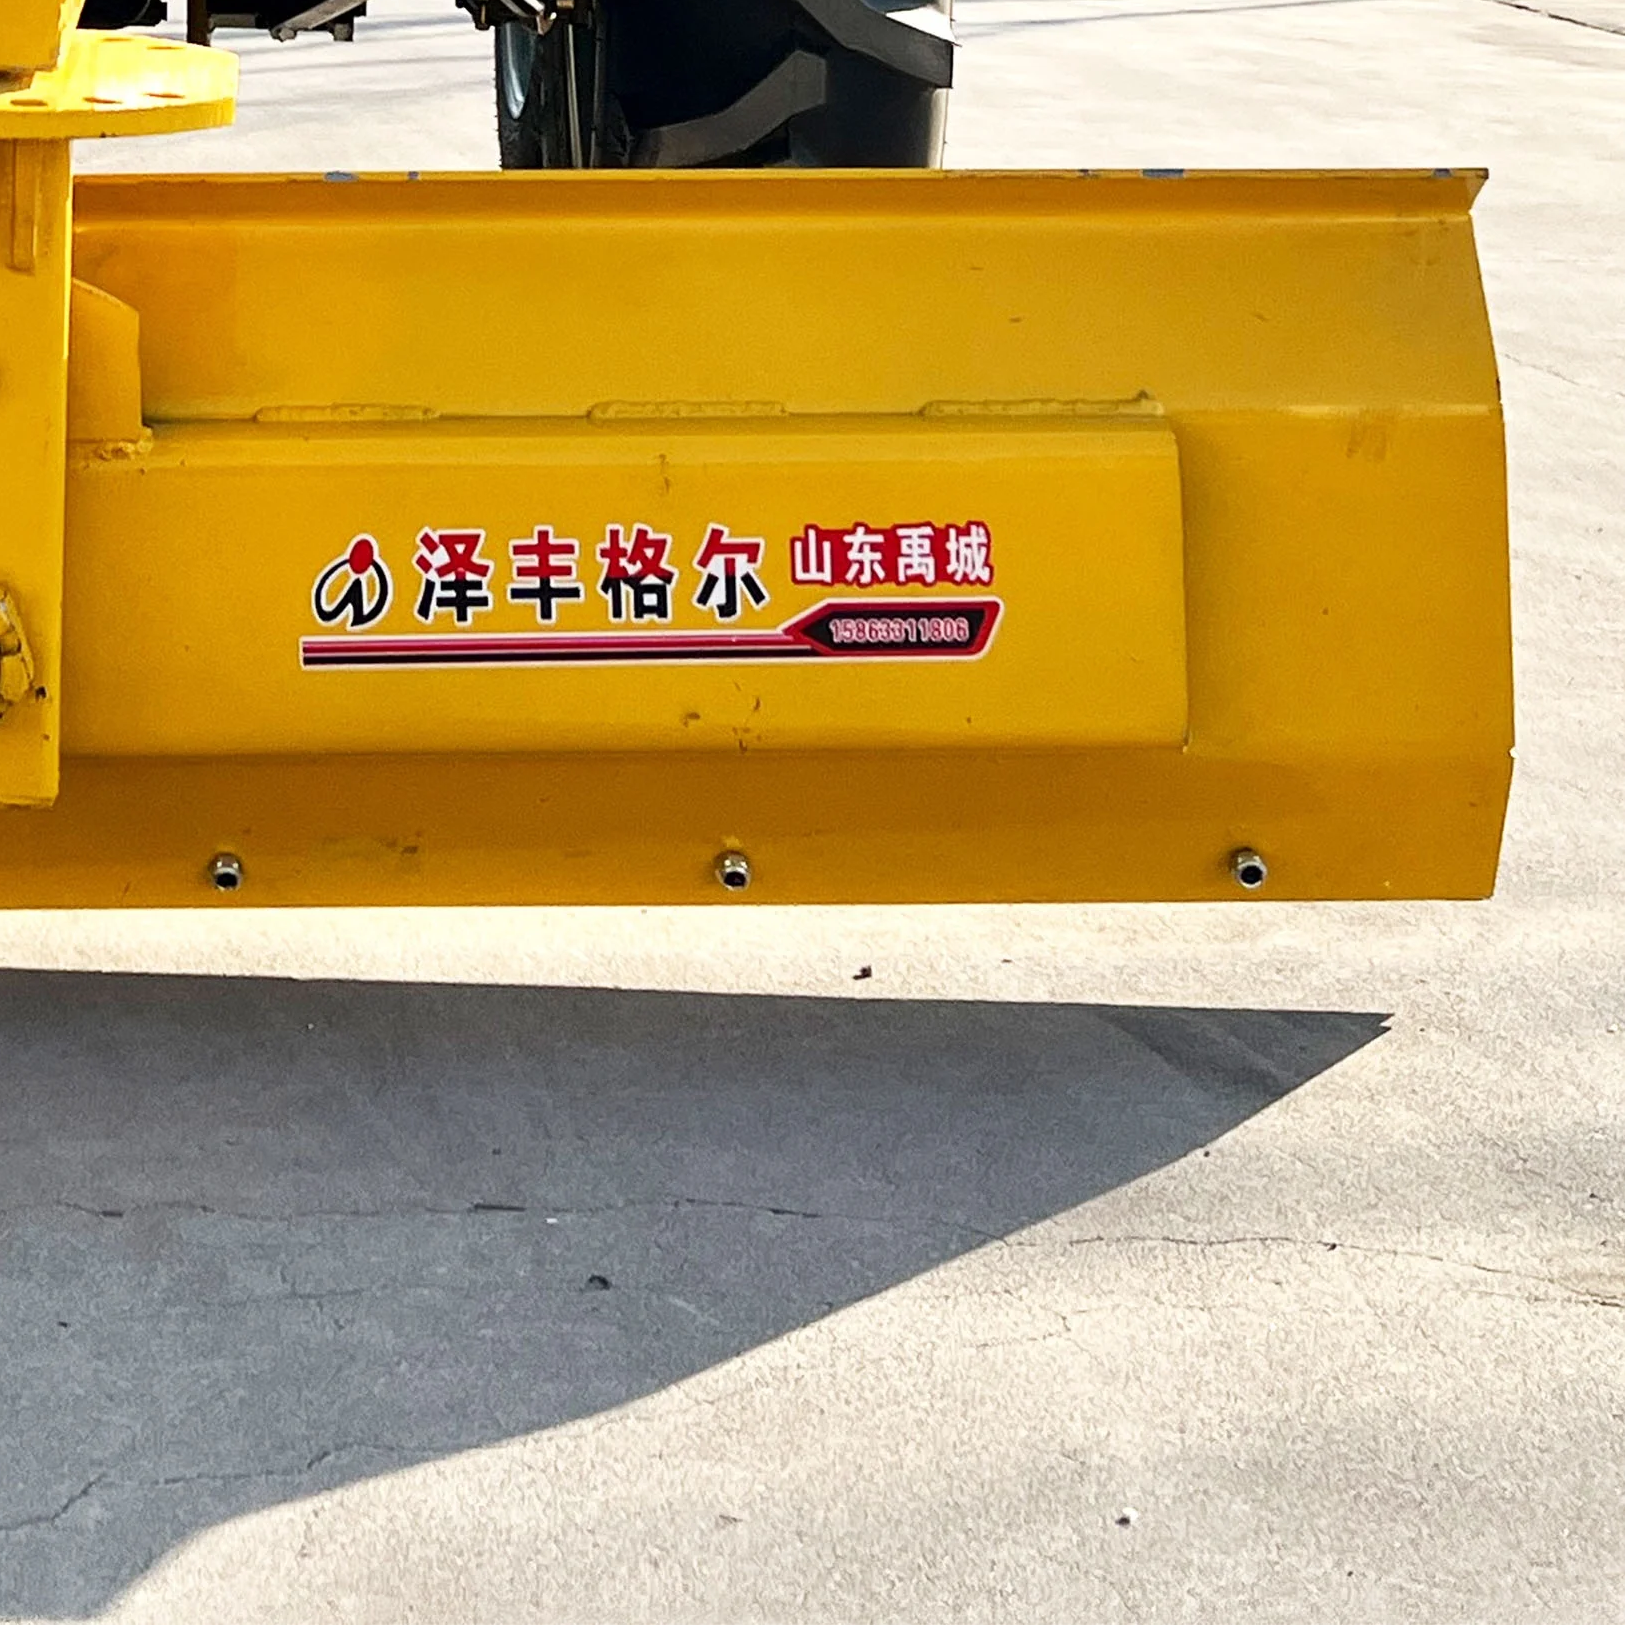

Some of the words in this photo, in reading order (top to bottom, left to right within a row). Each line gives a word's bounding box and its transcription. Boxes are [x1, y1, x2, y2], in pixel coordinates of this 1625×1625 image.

[417, 526, 767, 622] 泽丰格尔
[793, 525, 991, 585] 山东禹城
[829, 617, 970, 643] 15863311806
